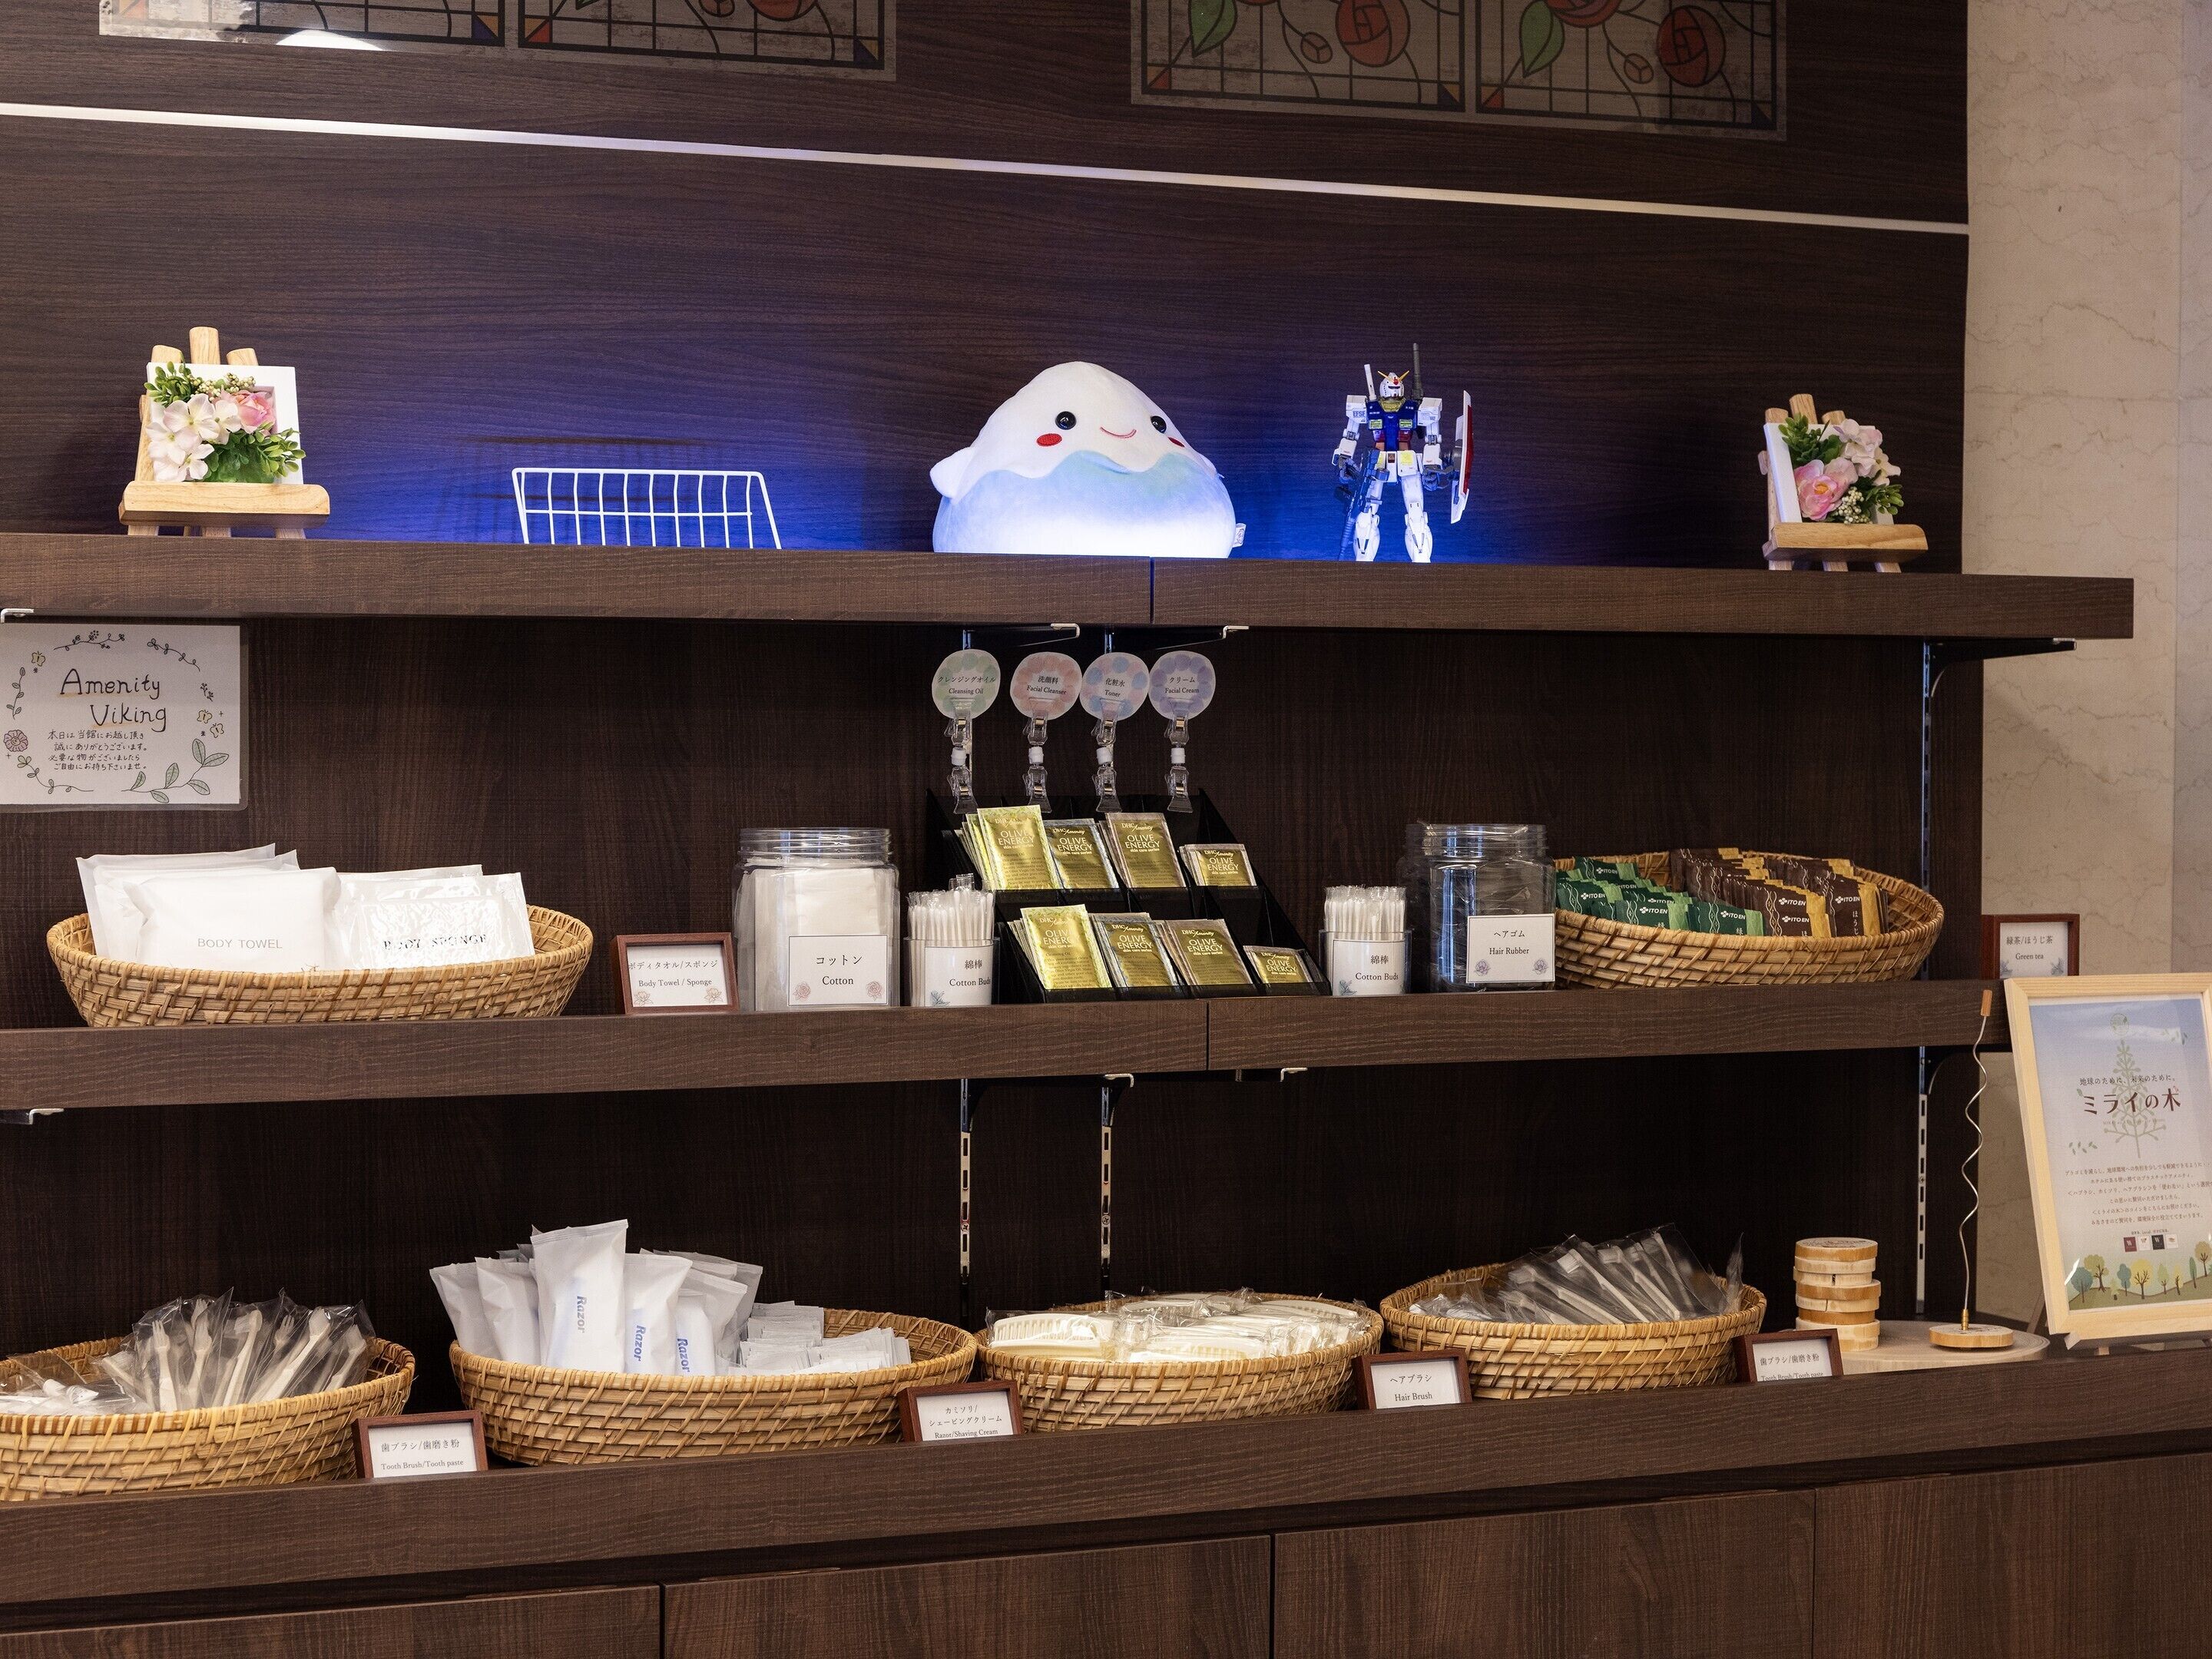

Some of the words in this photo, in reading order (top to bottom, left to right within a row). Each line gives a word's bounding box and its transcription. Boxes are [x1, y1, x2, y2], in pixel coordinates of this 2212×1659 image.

[60, 668, 160, 700] Amenity
[1038, 675, 1058, 684] 洗顔料
[1105, 677, 1125, 687] 化粧水
[1044, 687, 1067, 695] Cleanser
[1104, 689, 1121, 697] Toner
[90, 703, 166, 732] Viking
[48, 729, 144, 740] 本日は当館にお越し頂き
[1001, 830, 1029, 838] OLIVE
[998, 836, 1035, 846] ENERGY
[1045, 929, 1071, 938] OLIV
[1494, 929, 1525, 939] ヘアゴム
[197, 938, 233, 949] BODY
[237, 939, 283, 949] TOWEL
[2006, 935, 2053, 945] 緑茶/ほうじ茶
[629, 959, 718, 970] ボディタオル/スポンジ
[816, 955, 863, 966] コットン
[964, 959, 982, 969] 綿棒
[1370, 955, 1389, 965] 綿棒
[822, 975, 854, 985] Cotton
[979, 977, 992, 985] Buds
[1355, 972, 1382, 981] Cotton
[1384, 972, 1399, 981] Buds
[687, 979, 712, 987] Sponge
[2084, 1088, 2181, 1114] ミライの木
[577, 1296, 588, 1333] Razor
[634, 1325, 646, 1362] Razor
[677, 1338, 690, 1373] Razor
[1760, 1353, 1820, 1366] 歯ブラシ/歯磨き粉
[1389, 1374, 1432, 1384] ヘアブラシ
[1395, 1393, 1410, 1402] Hair
[1412, 1392, 1433, 1400] Brush
[945, 1405, 978, 1414] カミソリ/
[929, 1415, 1002, 1426] シェービングクリーム
[935, 1429, 978, 1439] Razor/Shaving
[381, 1439, 460, 1452] 歯ブラシ/歯磨き粉
[403, 1460, 445, 1469] Brush/Tooth
[447, 1460, 464, 1469] paste
